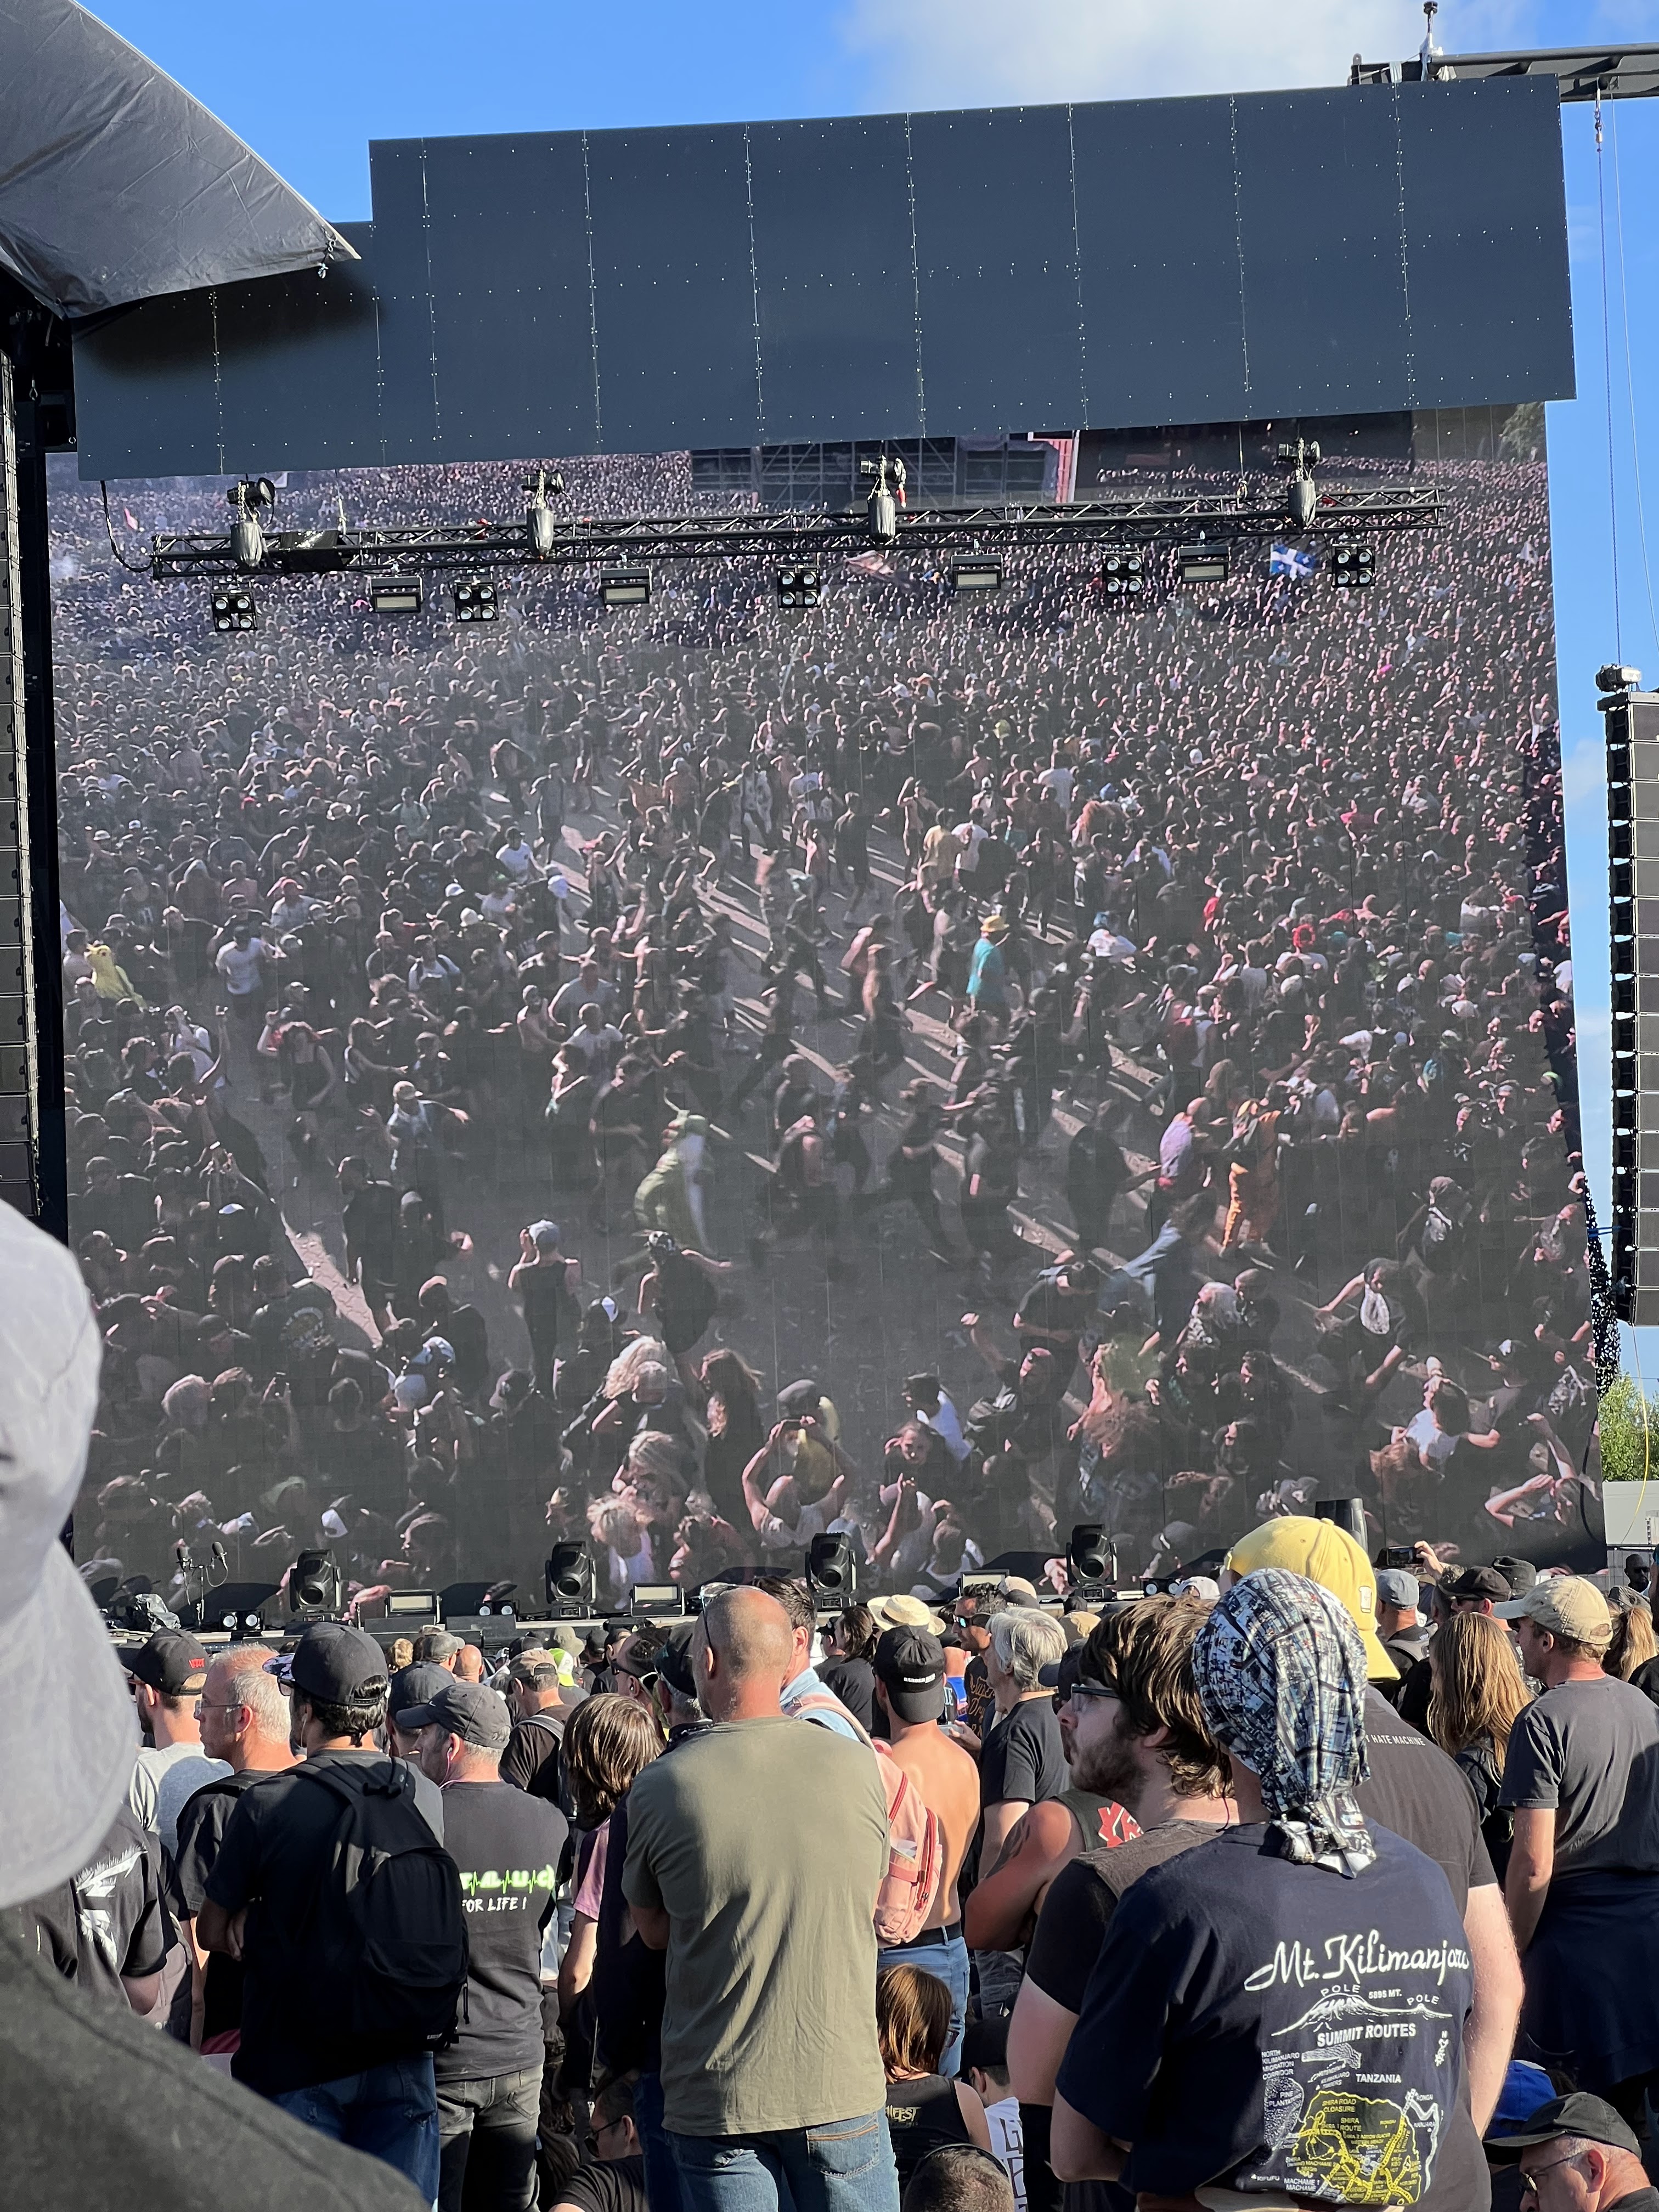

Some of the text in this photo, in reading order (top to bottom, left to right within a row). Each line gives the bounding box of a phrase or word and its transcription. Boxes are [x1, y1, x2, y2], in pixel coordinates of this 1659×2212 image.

[1370, 1734, 1393, 1744] HATE
[1391, 1735, 1426, 1746] MACHINE
[487, 1897, 519, 1912] LIFE
[1244, 1929, 1469, 1991] Mt. Kilimanjaro
[1321, 1984, 1361, 1997] POLE
[1368, 1989, 1402, 1999] 5895 MT.
[1407, 1994, 1440, 2006] POLE
[1317, 2023, 1417, 2047] SUMMIT ROUTES
[1261, 2049, 1280, 2058] NORTH
[1262, 2061, 1294, 2072] MIGRATION
[1263, 2069, 1294, 2080] CORRIDOR
[1356, 2073, 1402, 2083] TANZANIA
